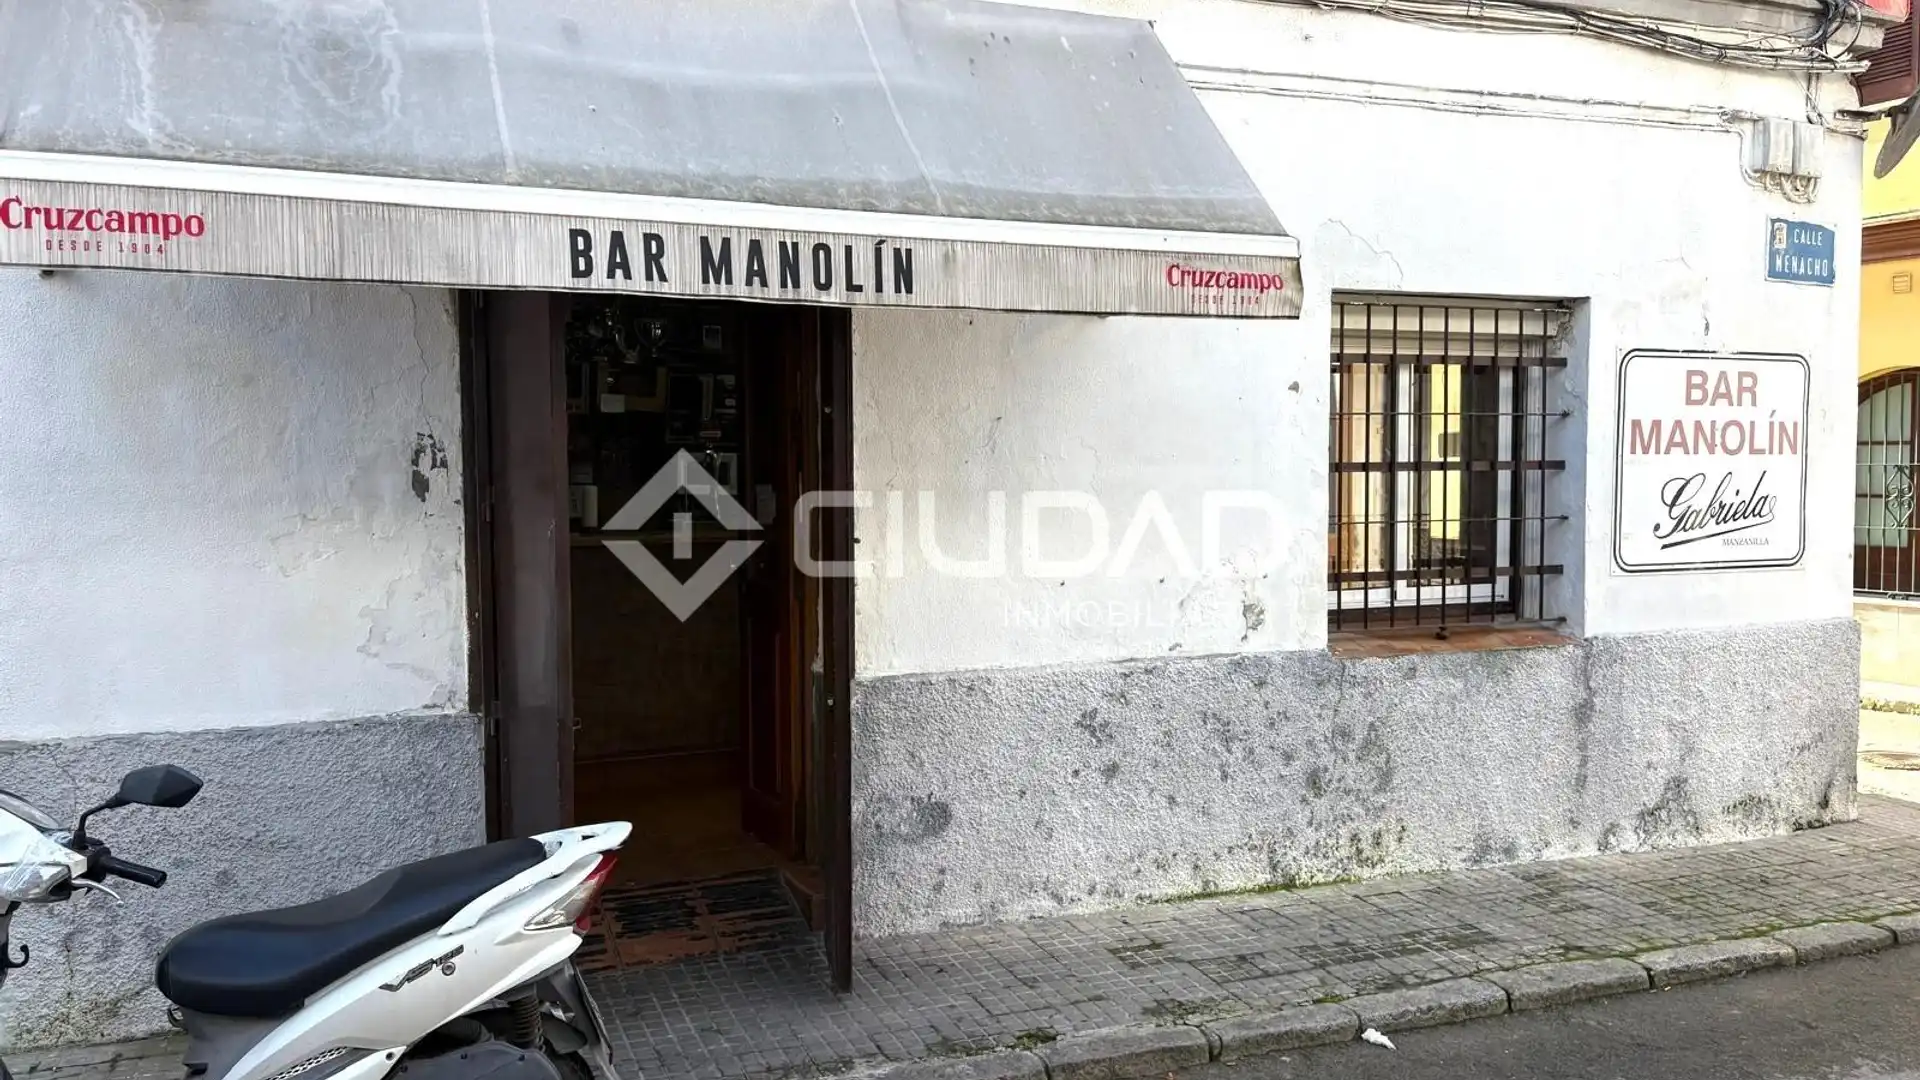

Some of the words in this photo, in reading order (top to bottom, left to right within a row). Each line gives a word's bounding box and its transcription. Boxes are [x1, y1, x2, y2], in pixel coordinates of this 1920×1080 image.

[0, 195, 206, 241] Cruzcampo
[1793, 228, 1823, 246] CALLE
[46, 239, 103, 252] DESDE
[118, 242, 164, 255] 1904
[568, 228, 669, 283] BAR
[700, 236, 914, 295] MANOLÍN
[1166, 263, 1284, 294] Cruzcampo
[1685, 369, 1758, 407] BAR
[1629, 409, 1799, 455] MANOLÍN
[1653, 470, 1773, 539] Gabriela
[1722, 537, 1770, 547] MANZANILLA
